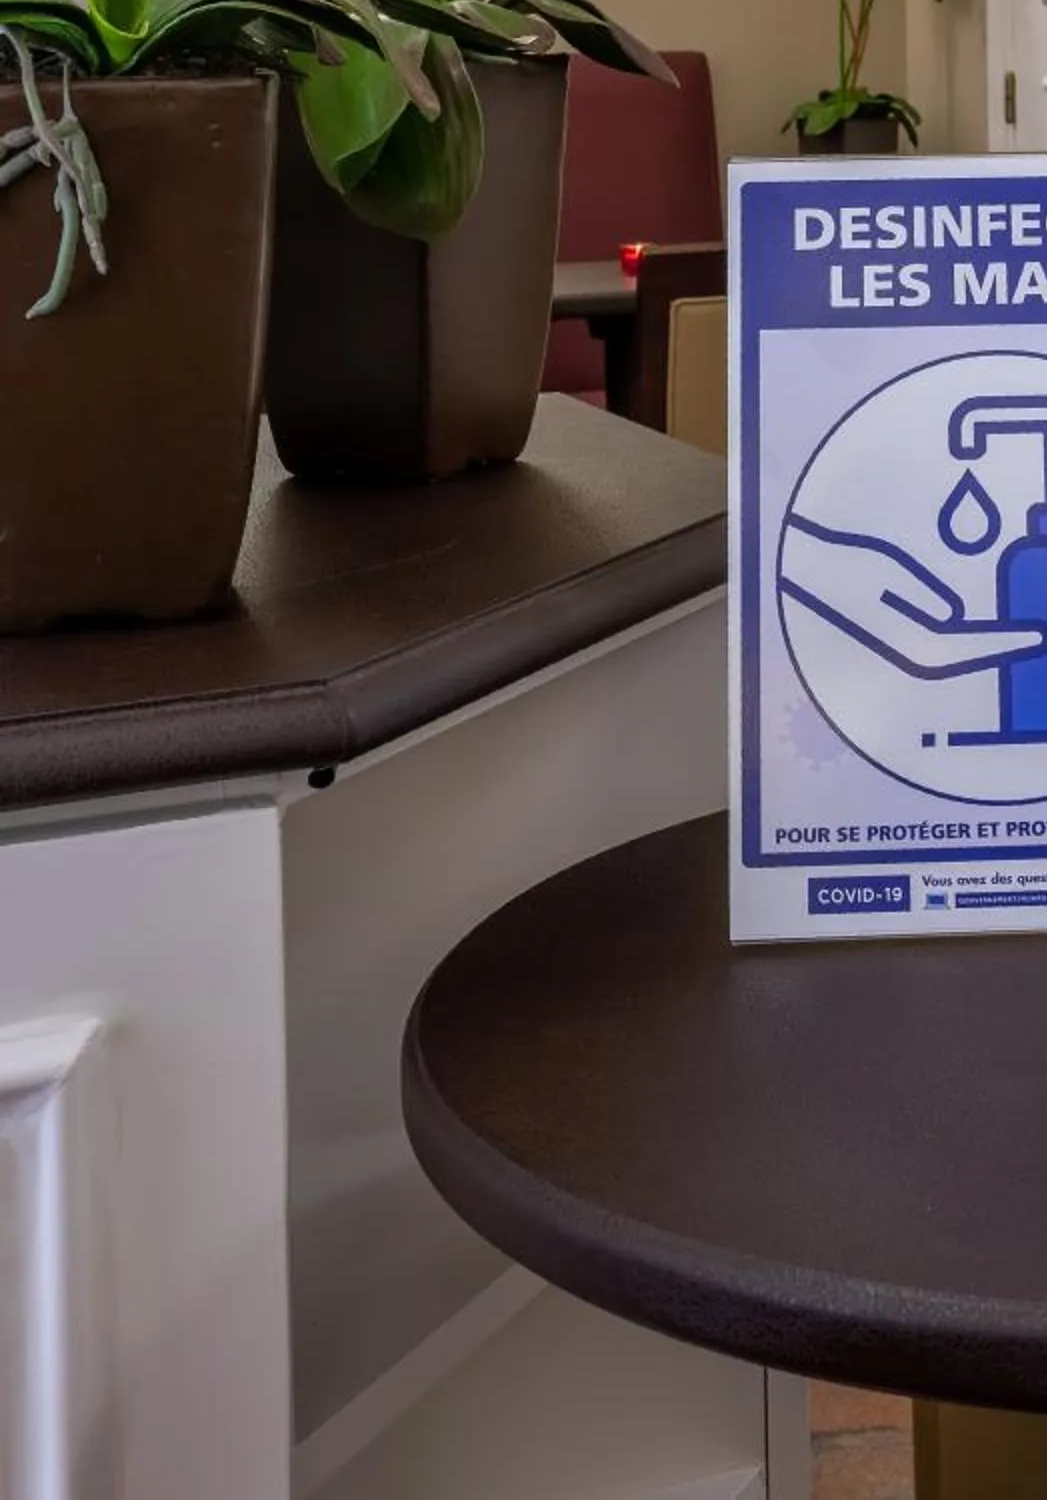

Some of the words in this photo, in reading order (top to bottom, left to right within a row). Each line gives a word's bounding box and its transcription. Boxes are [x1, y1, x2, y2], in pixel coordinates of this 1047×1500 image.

[829, 263, 931, 308] LES
[775, 827, 830, 844] POUR
[837, 826, 861, 843] SE
[867, 820, 971, 842] PROTÉGER
[977, 822, 1000, 839] ET
[922, 875, 953, 887] Vous
[957, 875, 987, 885] avez
[991, 872, 1013, 885] des
[817, 887, 903, 905] COVID-19
